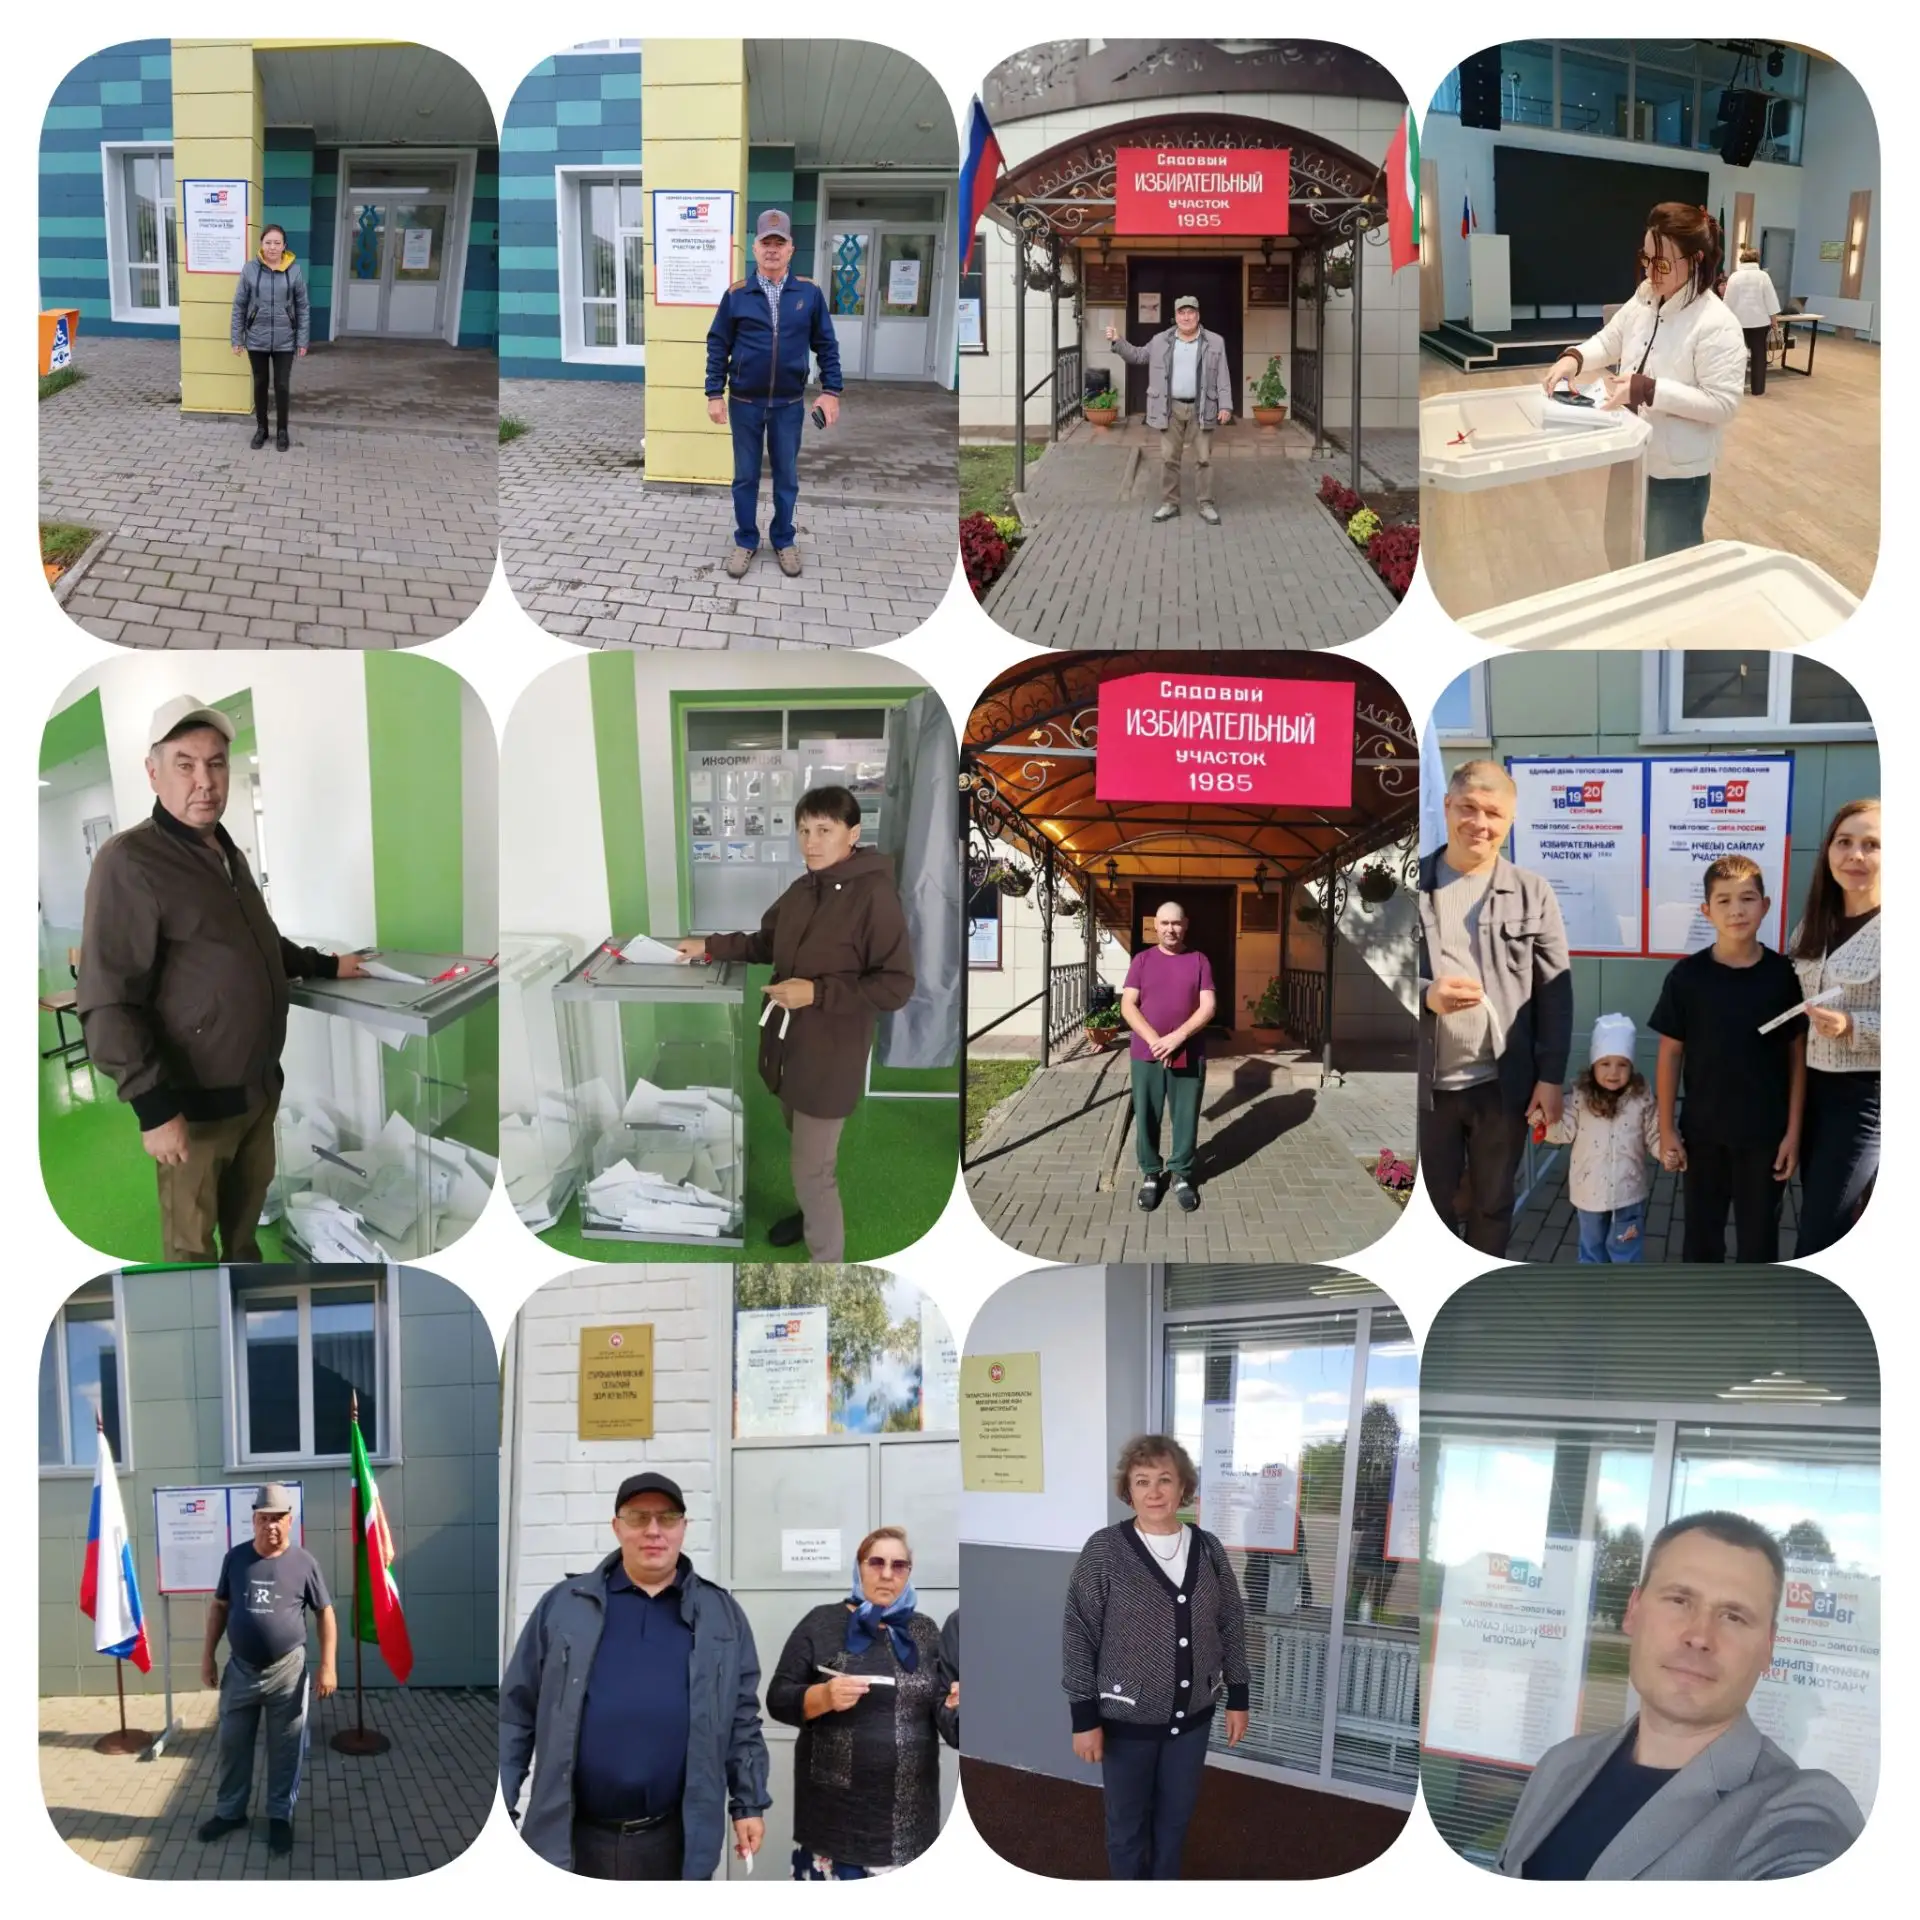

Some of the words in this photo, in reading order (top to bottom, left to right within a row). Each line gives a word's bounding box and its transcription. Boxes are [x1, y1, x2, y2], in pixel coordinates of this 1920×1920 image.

[1134, 171, 1263, 193] ИЗБИРАТЕЛЬНЫЙ
[1177, 213, 1222, 227] 1985
[1126, 707, 1316, 745] ИЗБИРАТЕЛЬНЫЙ
[702, 754, 782, 767] ИНФОРМАЦИЯ
[1529, 767, 1556, 775] ЕДИНЫЙ
[1669, 766, 1698, 774] ЕДИНЫЙ
[1189, 772, 1253, 792] 1985
[1552, 798, 1566, 809] 18
[1568, 791, 1582, 803] 19
[1583, 786, 1601, 798] 20
[1692, 797, 1707, 809] 18
[1709, 791, 1725, 803] 19
[1726, 785, 1744, 798] 20
[1540, 839, 1616, 849] ИЗБИРАТЕЛЬНЫЙ
[1691, 841, 1725, 851] НЧЕ(Ы)
[1726, 840, 1765, 851] САЙЛАУ
[1542, 851, 1582, 860] УЧАСТОК
[1262, 1468, 1283, 1478] 1988
